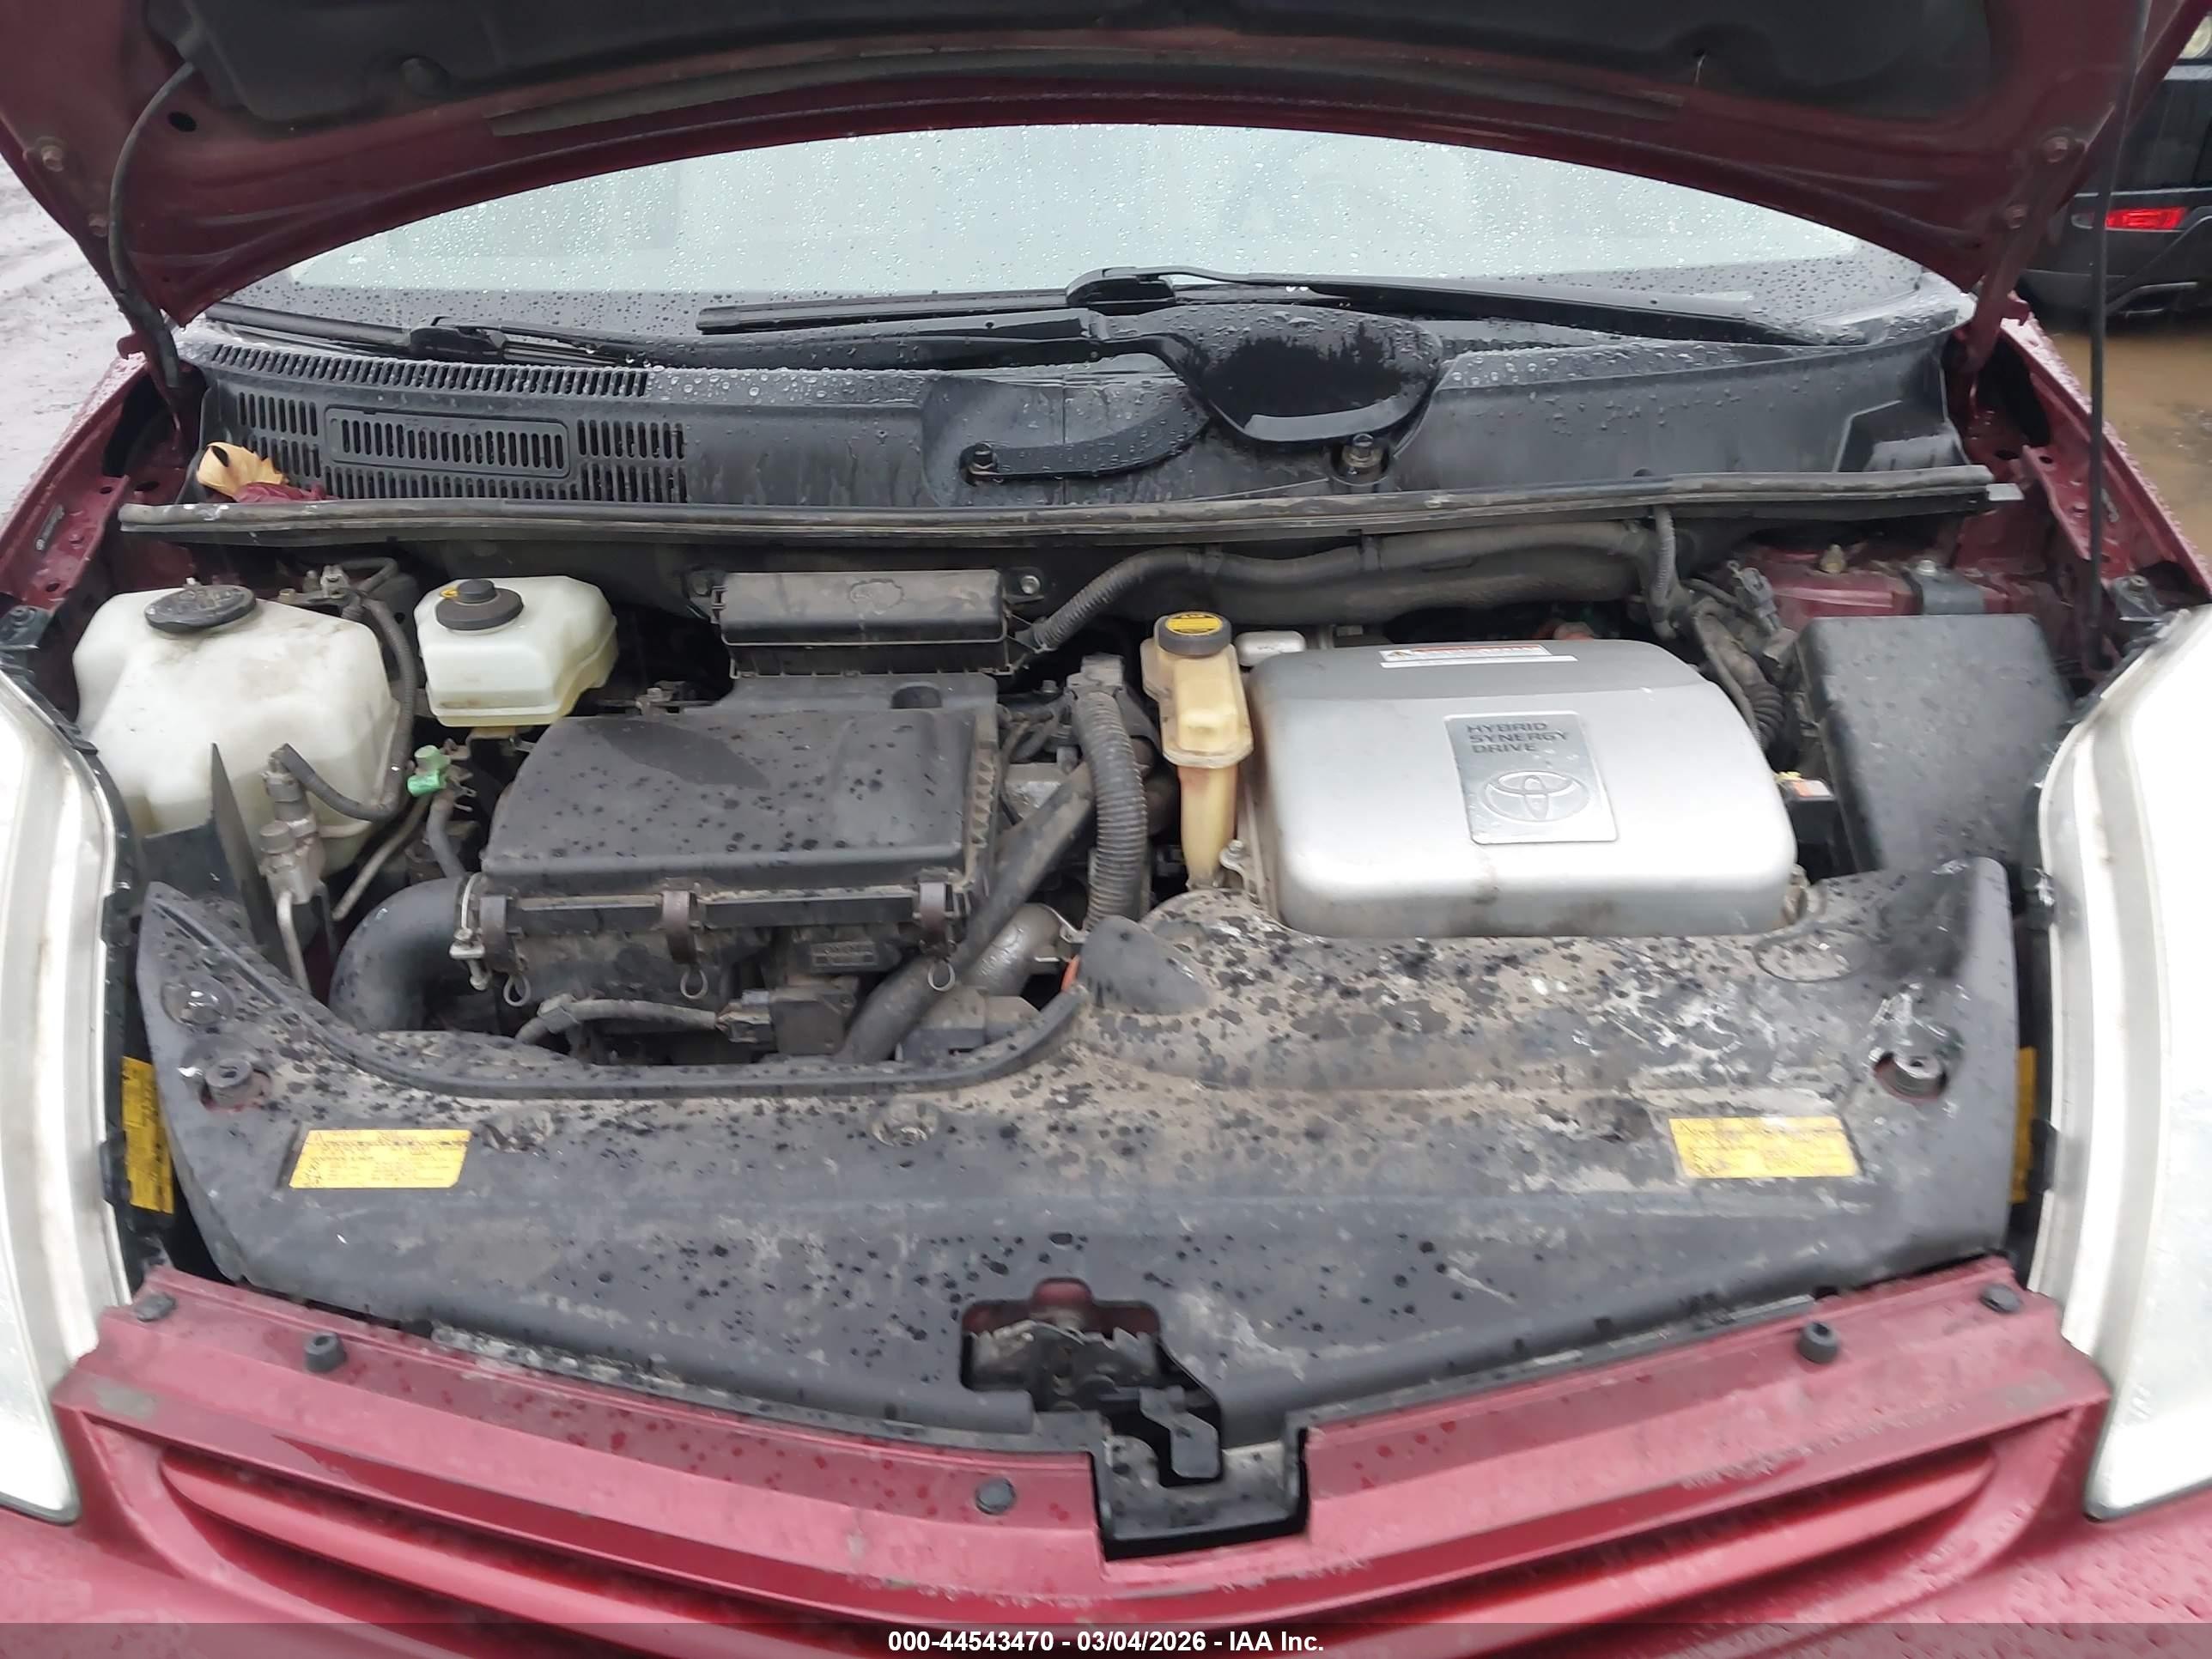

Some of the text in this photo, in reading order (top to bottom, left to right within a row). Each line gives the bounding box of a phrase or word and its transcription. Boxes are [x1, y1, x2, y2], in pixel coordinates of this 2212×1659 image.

[1466, 723, 1547, 732] HYBRID
[1469, 731, 1567, 743] SYNERGY
[1471, 743, 1536, 753] DRIVE
